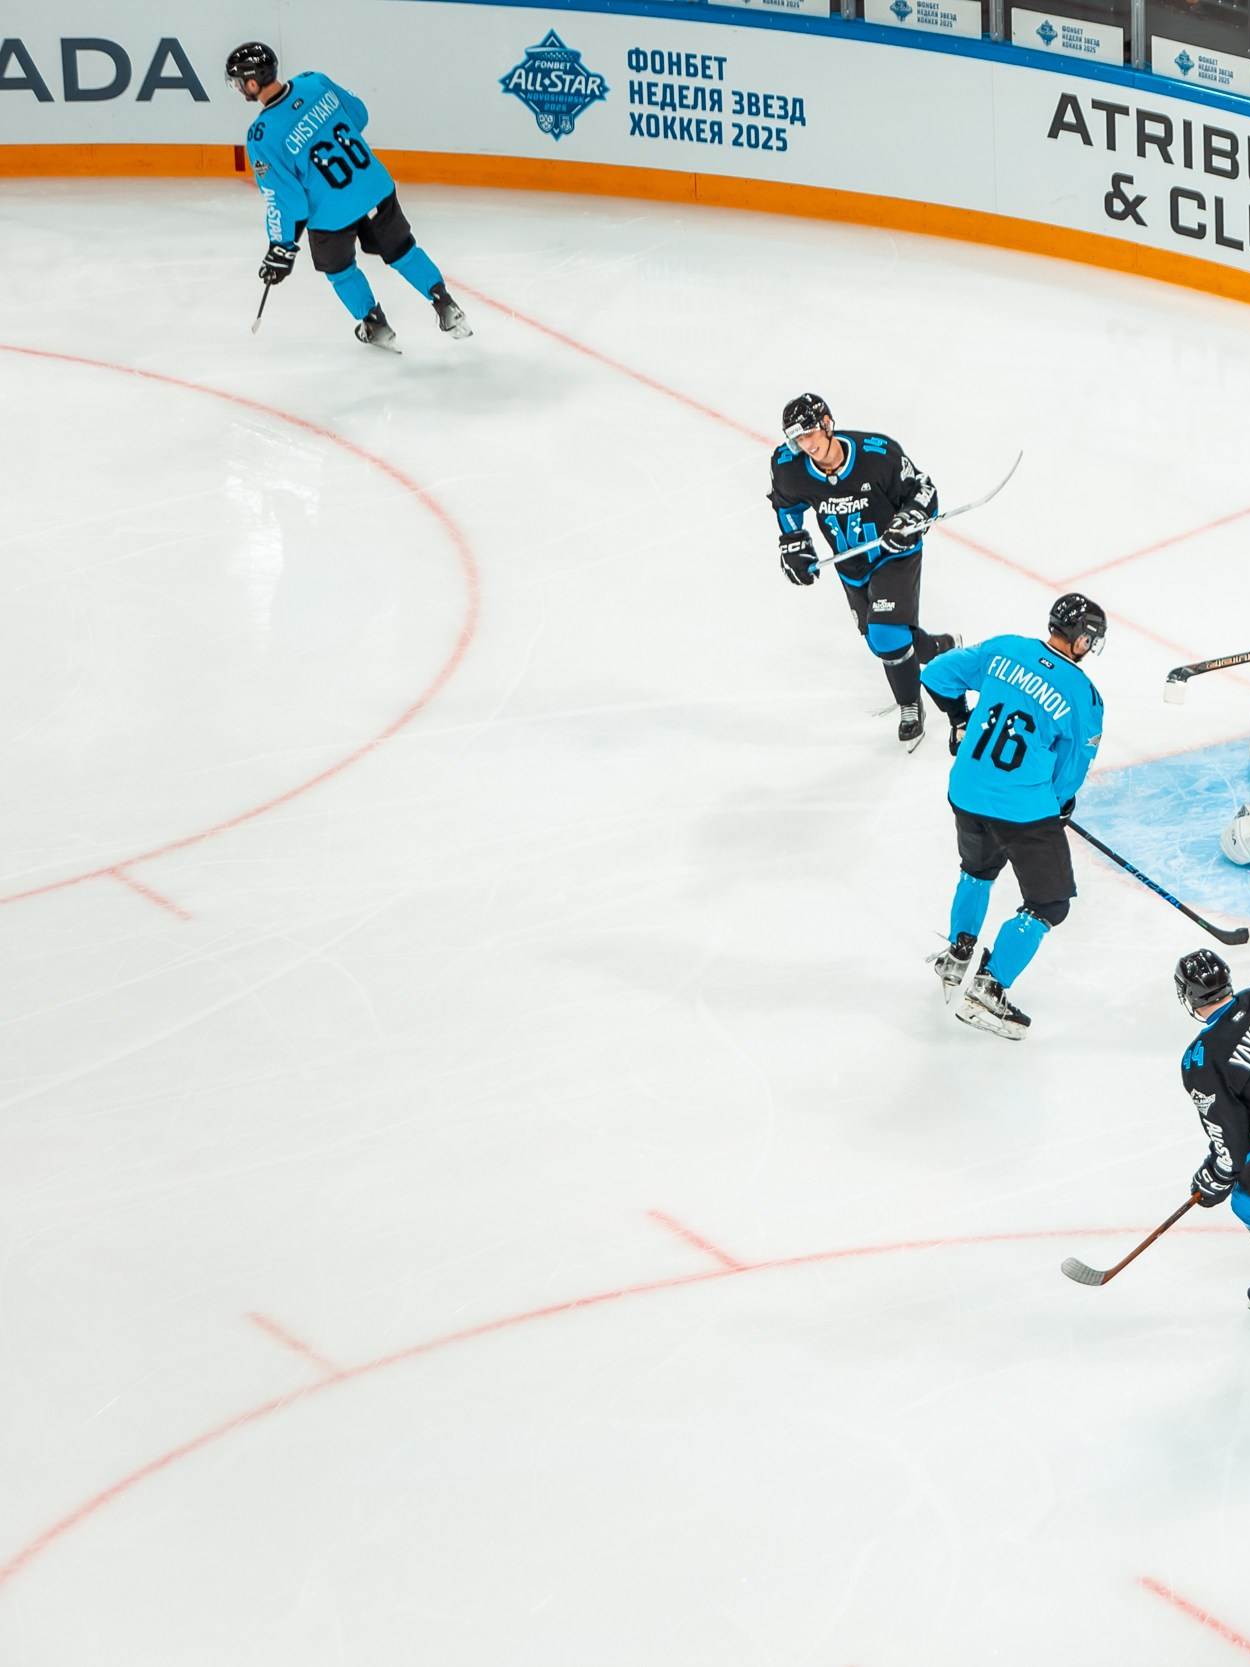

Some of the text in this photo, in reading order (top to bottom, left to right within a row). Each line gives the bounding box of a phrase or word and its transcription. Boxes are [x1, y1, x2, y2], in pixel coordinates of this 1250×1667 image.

[917, 1, 939, 10] ФОНБЕТ
[917, 9, 957, 21] НЕДЕЛЯ ЗВЕЗД
[917, 16, 953, 28] ХОККЕЯ 2025
[535, 60, 571, 71] FONBET
[627, 46, 728, 81] ФОНБЕТ
[544, 103, 567, 112] 2025
[629, 79, 807, 127] НЕДЕЛЯ ЗВЕЗД
[629, 111, 788, 152] ХОККЕЯ 2025
[309, 121, 371, 190] 66
[1104, 173, 1149, 228] &
[987, 655, 1072, 721] FILIMONOV
[971, 702, 1037, 772] 16
